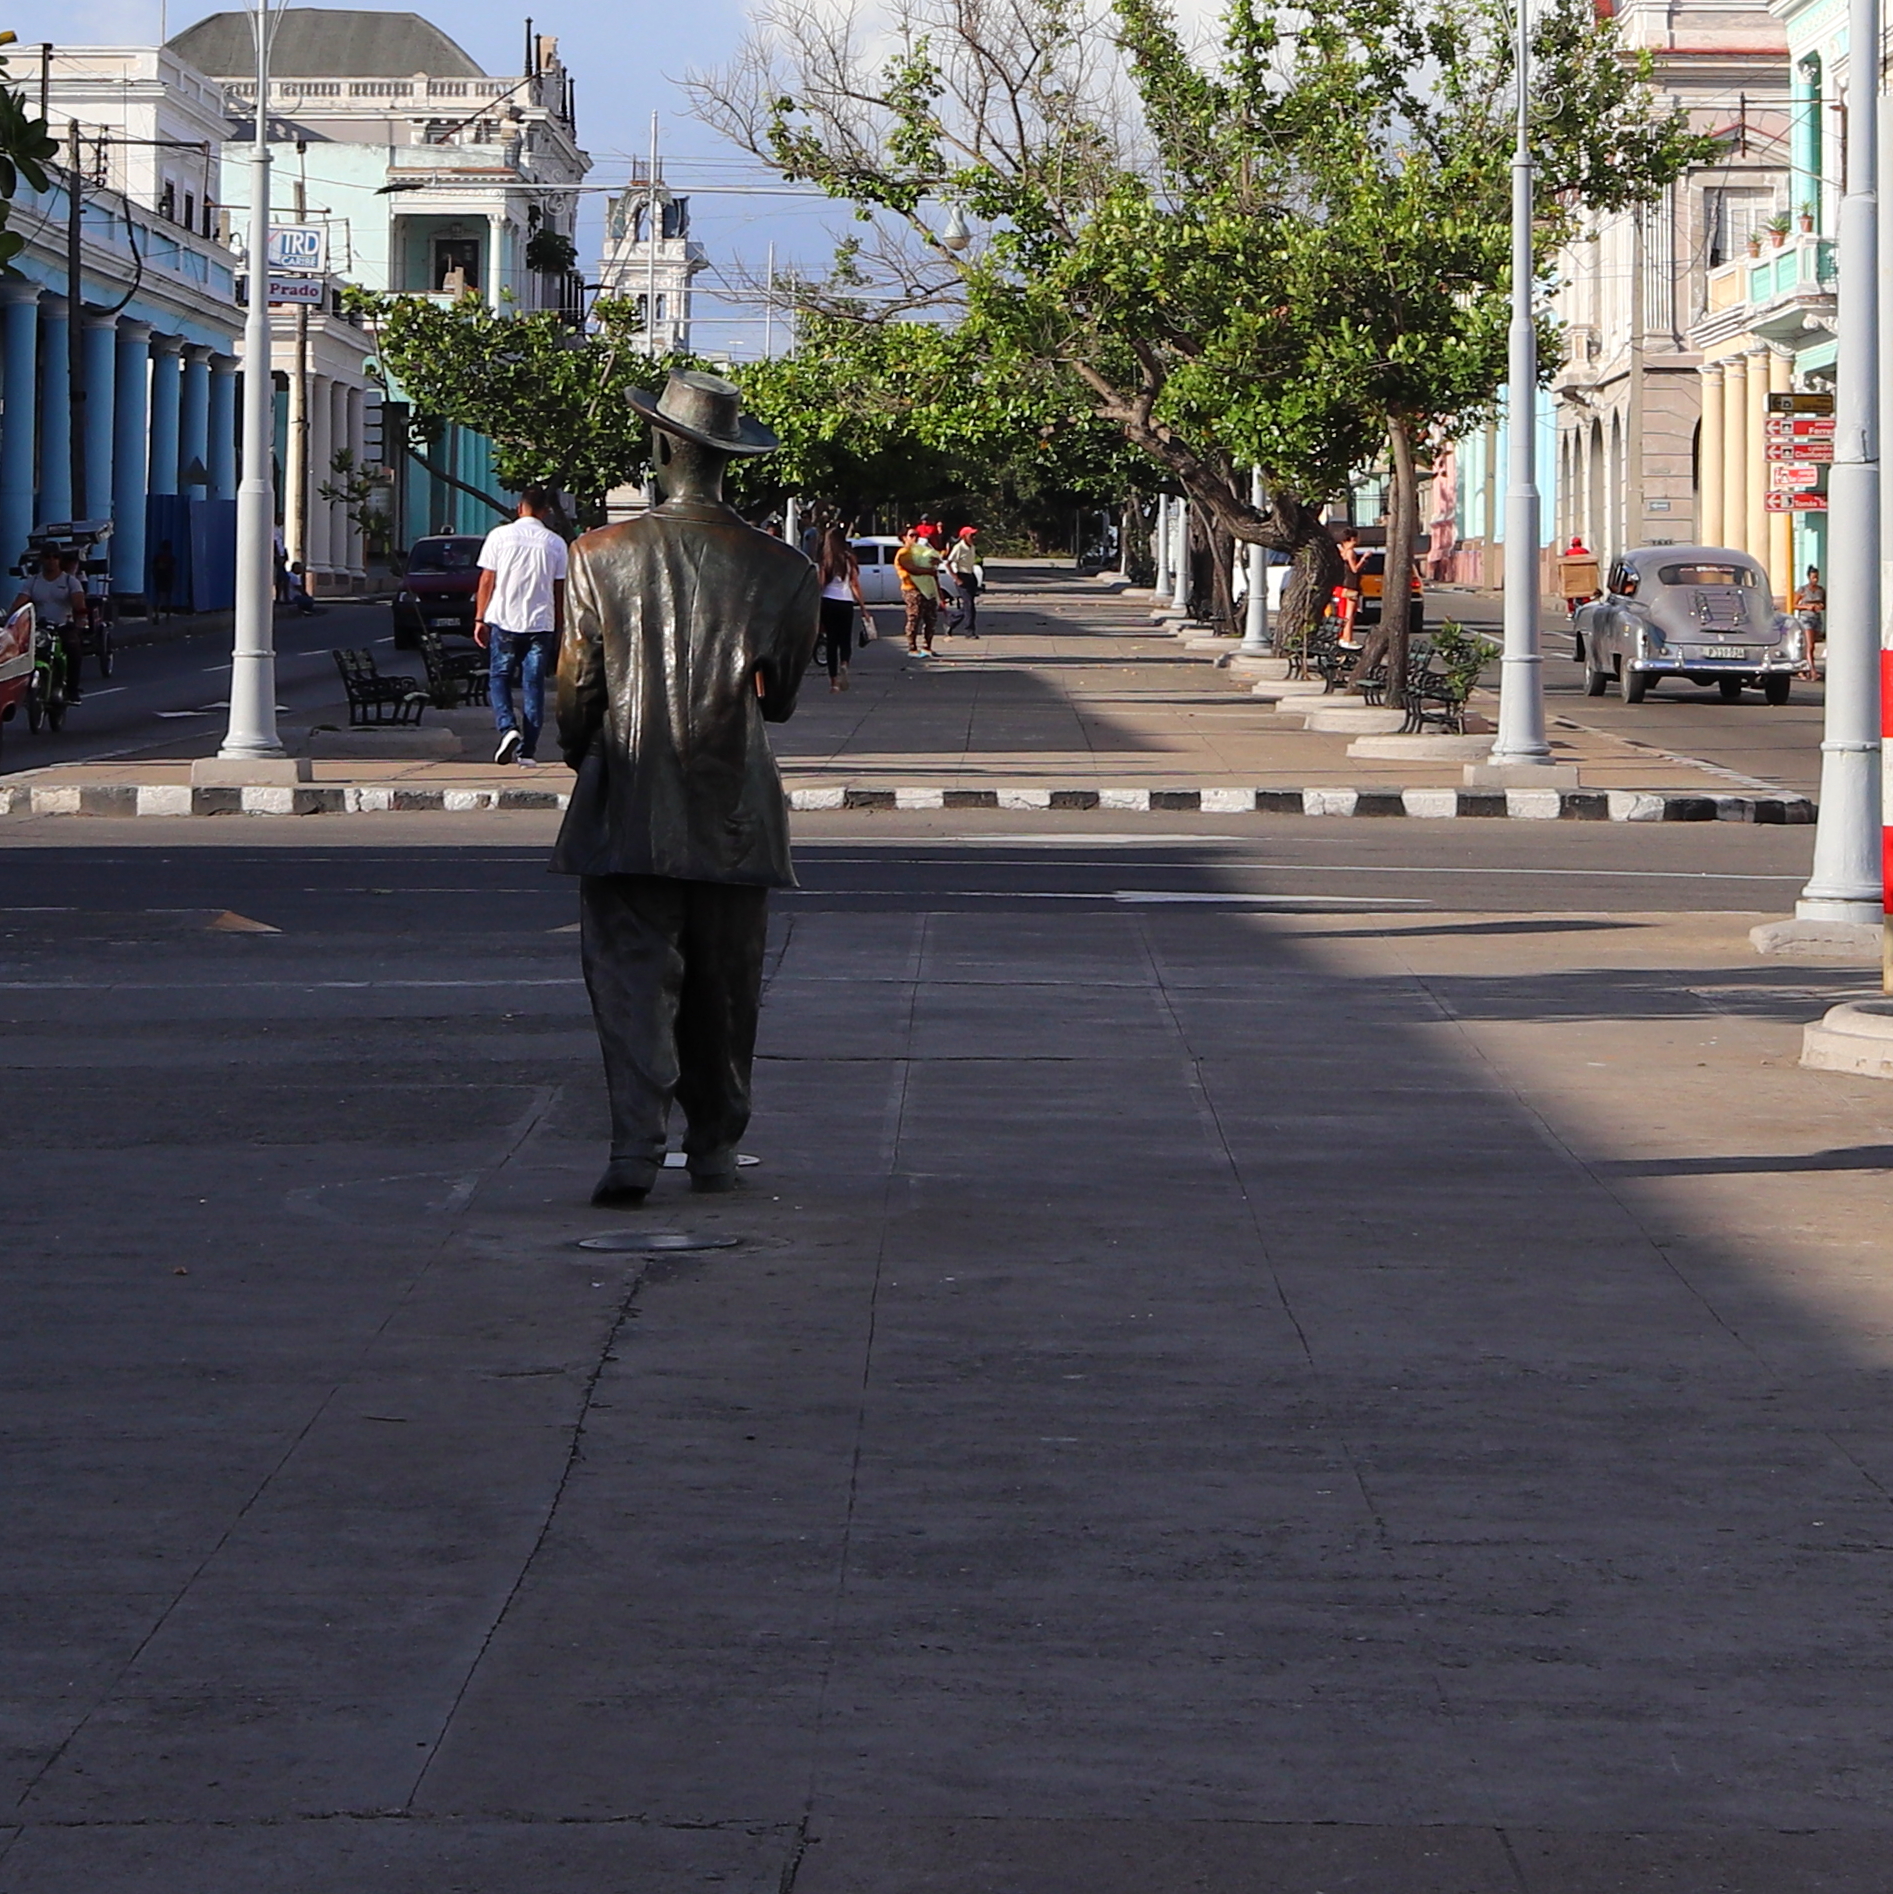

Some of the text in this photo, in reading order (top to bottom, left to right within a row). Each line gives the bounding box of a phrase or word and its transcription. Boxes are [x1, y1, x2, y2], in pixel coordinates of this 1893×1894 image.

[282, 230, 319, 255] TRD
[281, 257, 316, 267] CARIBE
[269, 283, 319, 297] Prado
[1795, 451, 1833, 460] Cienfuego
